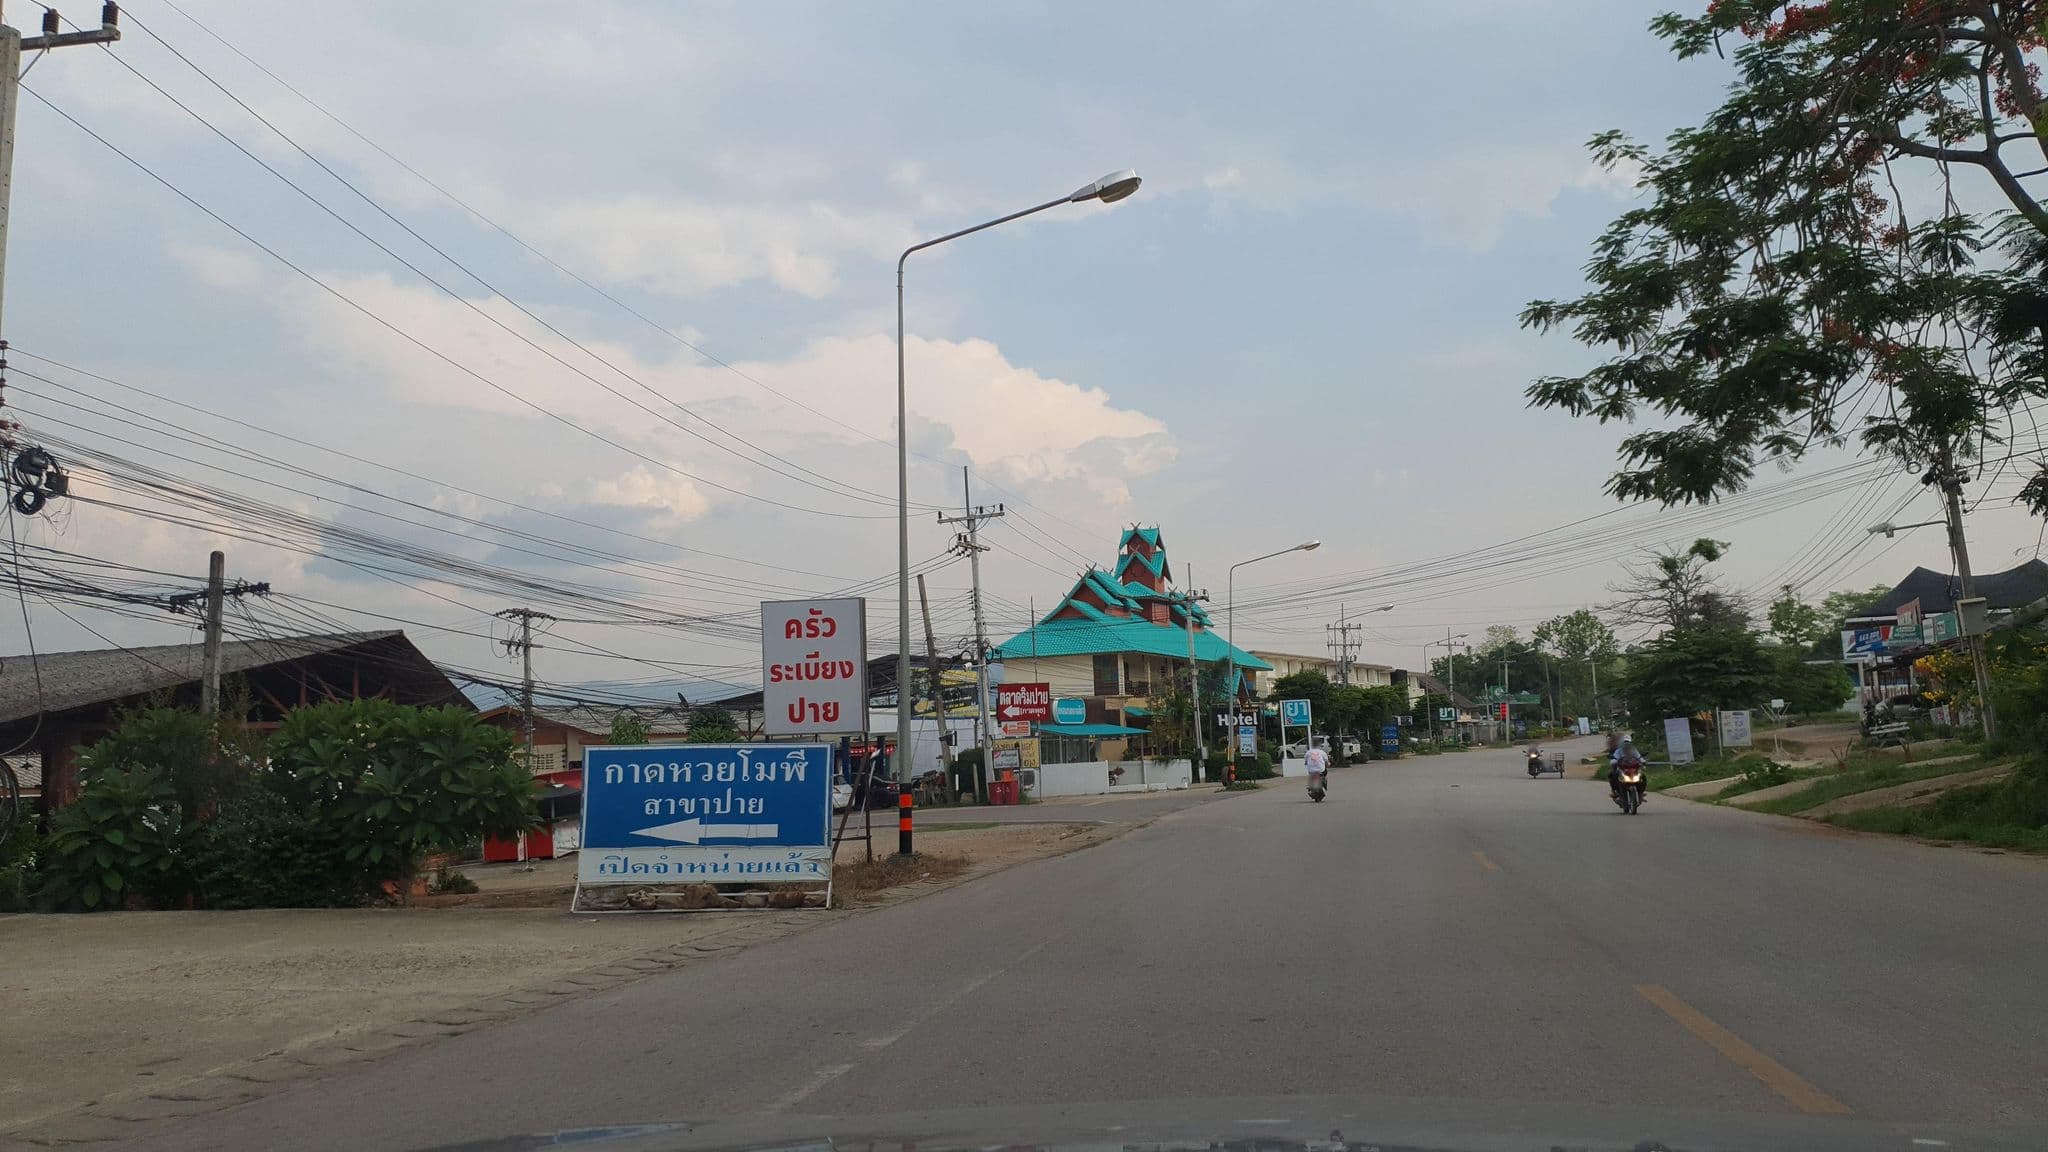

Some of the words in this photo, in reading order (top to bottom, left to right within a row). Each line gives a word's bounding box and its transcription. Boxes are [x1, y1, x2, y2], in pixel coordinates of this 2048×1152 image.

[785, 608, 837, 639] ครัว
[770, 651, 854, 683] ระเบียง
[1000, 686, 1049, 705] ตลาดริมปาย
[788, 697, 840, 724] ปาย
[1217, 712, 1258, 726] Hotel
[1286, 702, 1308, 717] ยา
[1439, 707, 1456, 718] ยา
[644, 788, 764, 815] สาขาปาย
[599, 852, 818, 874] เปิดจำหน่ายแล้ว
